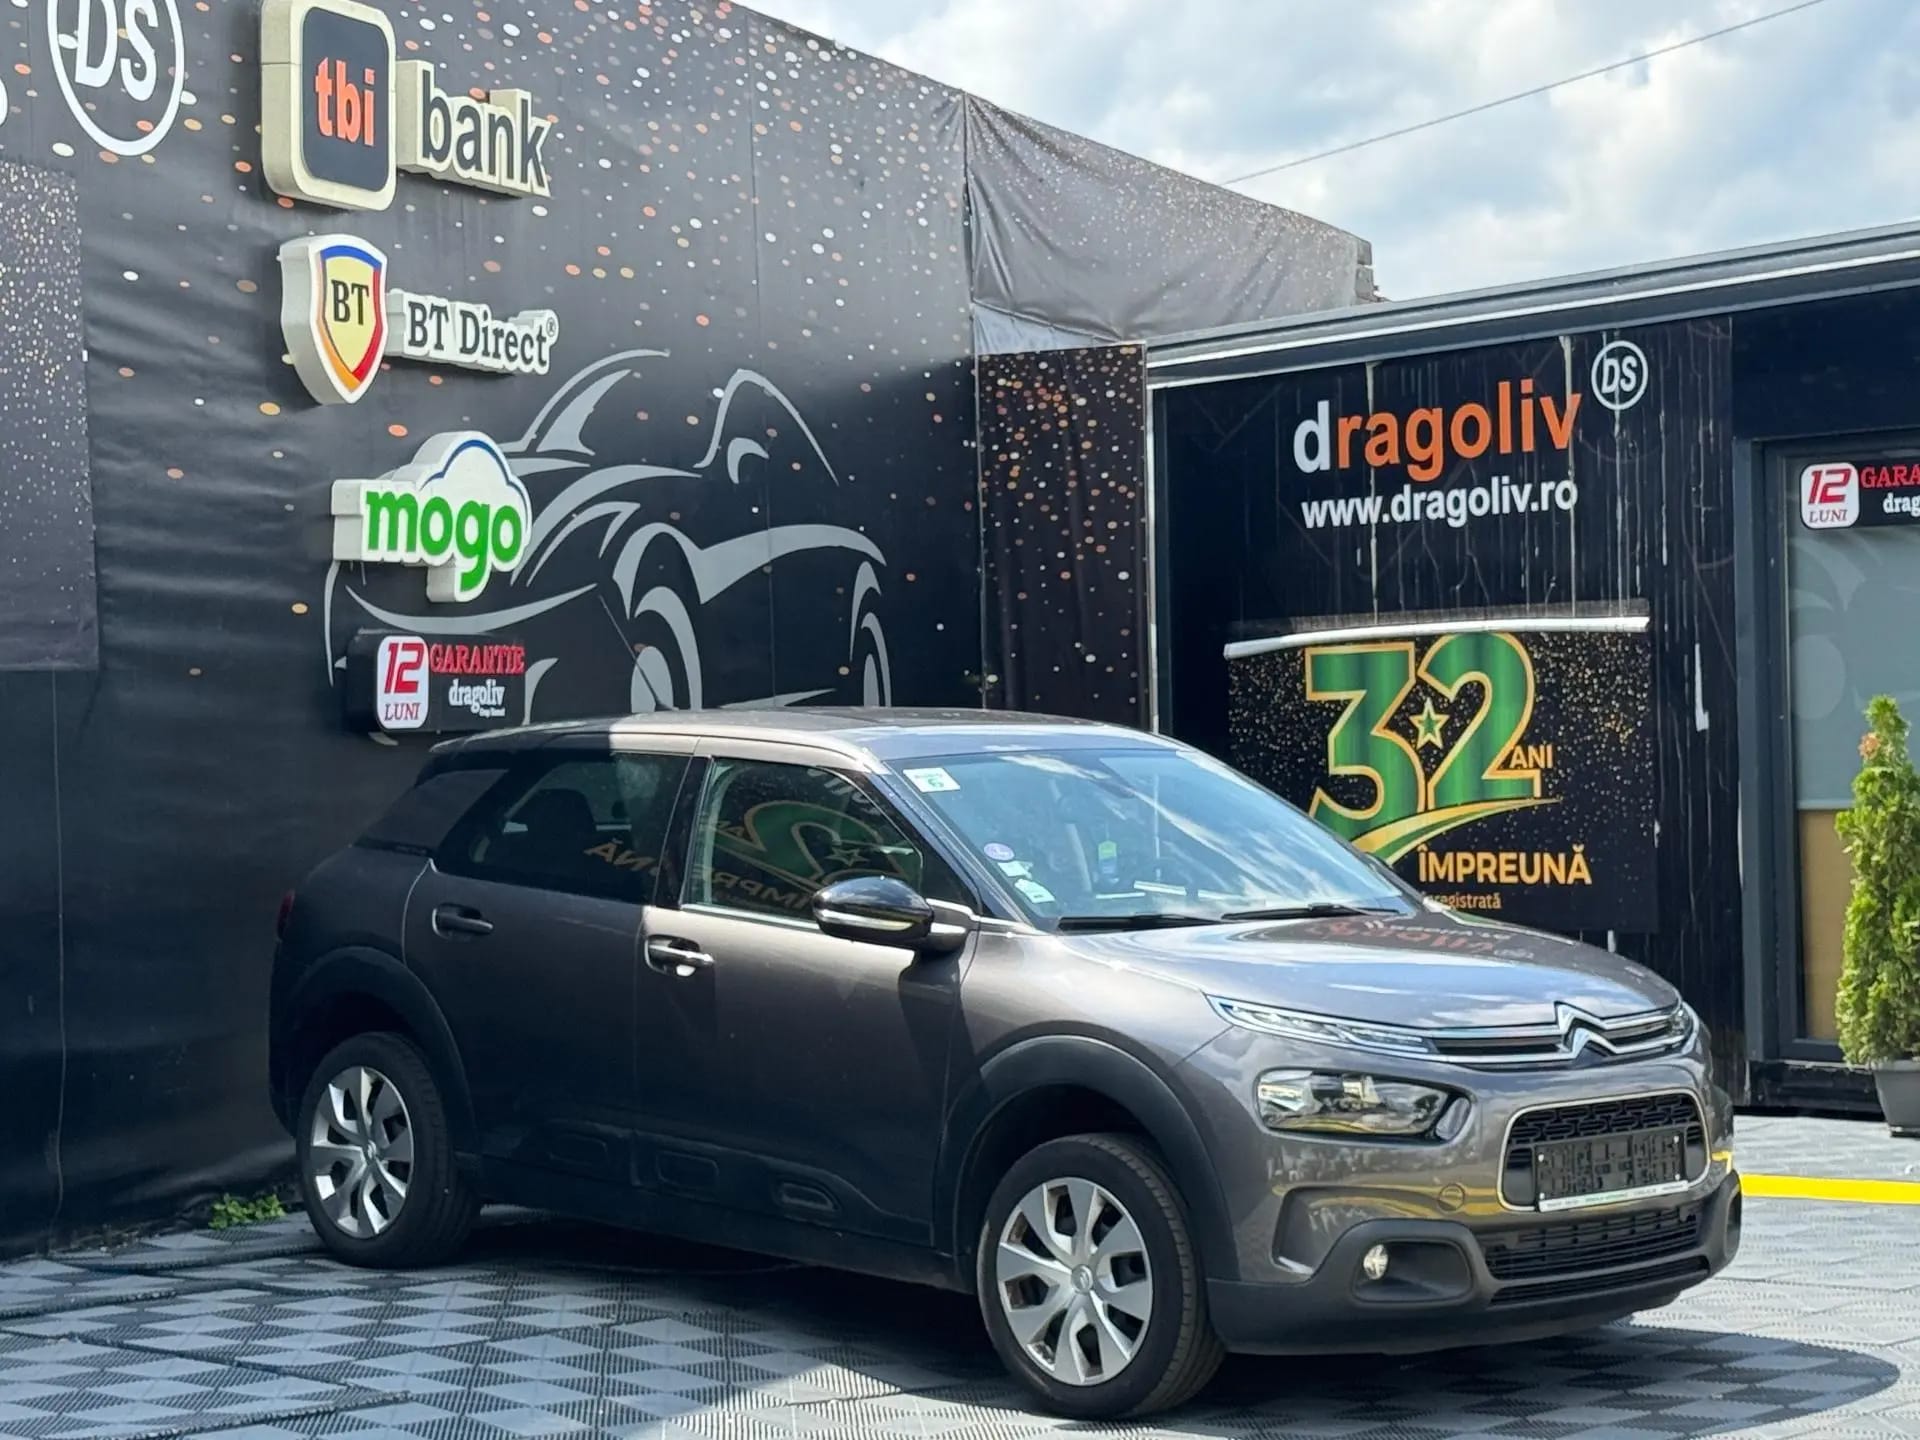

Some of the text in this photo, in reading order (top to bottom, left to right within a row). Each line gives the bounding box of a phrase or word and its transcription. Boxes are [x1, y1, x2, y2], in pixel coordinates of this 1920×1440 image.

[75, 0, 158, 101] DS
[315, 57, 545, 188] tbi bank
[331, 279, 369, 326] BT
[408, 301, 449, 351] BT
[1602, 355, 1637, 393] DS
[1294, 378, 1582, 481] dragoliv
[1302, 476, 1578, 528] www.dragoliv.ro
[1808, 468, 1852, 504] 12
[1809, 510, 1848, 523] LUNI
[366, 490, 522, 593] mogo
[384, 643, 424, 694] 12
[430, 643, 525, 674] GARANTIE
[384, 703, 421, 721] LUNI
[448, 678, 505, 713] dragoliv
[1305, 632, 1541, 845] 32
[1509, 745, 1553, 769] ANI
[1417, 843, 1592, 885] ÎMPREUNĂ
